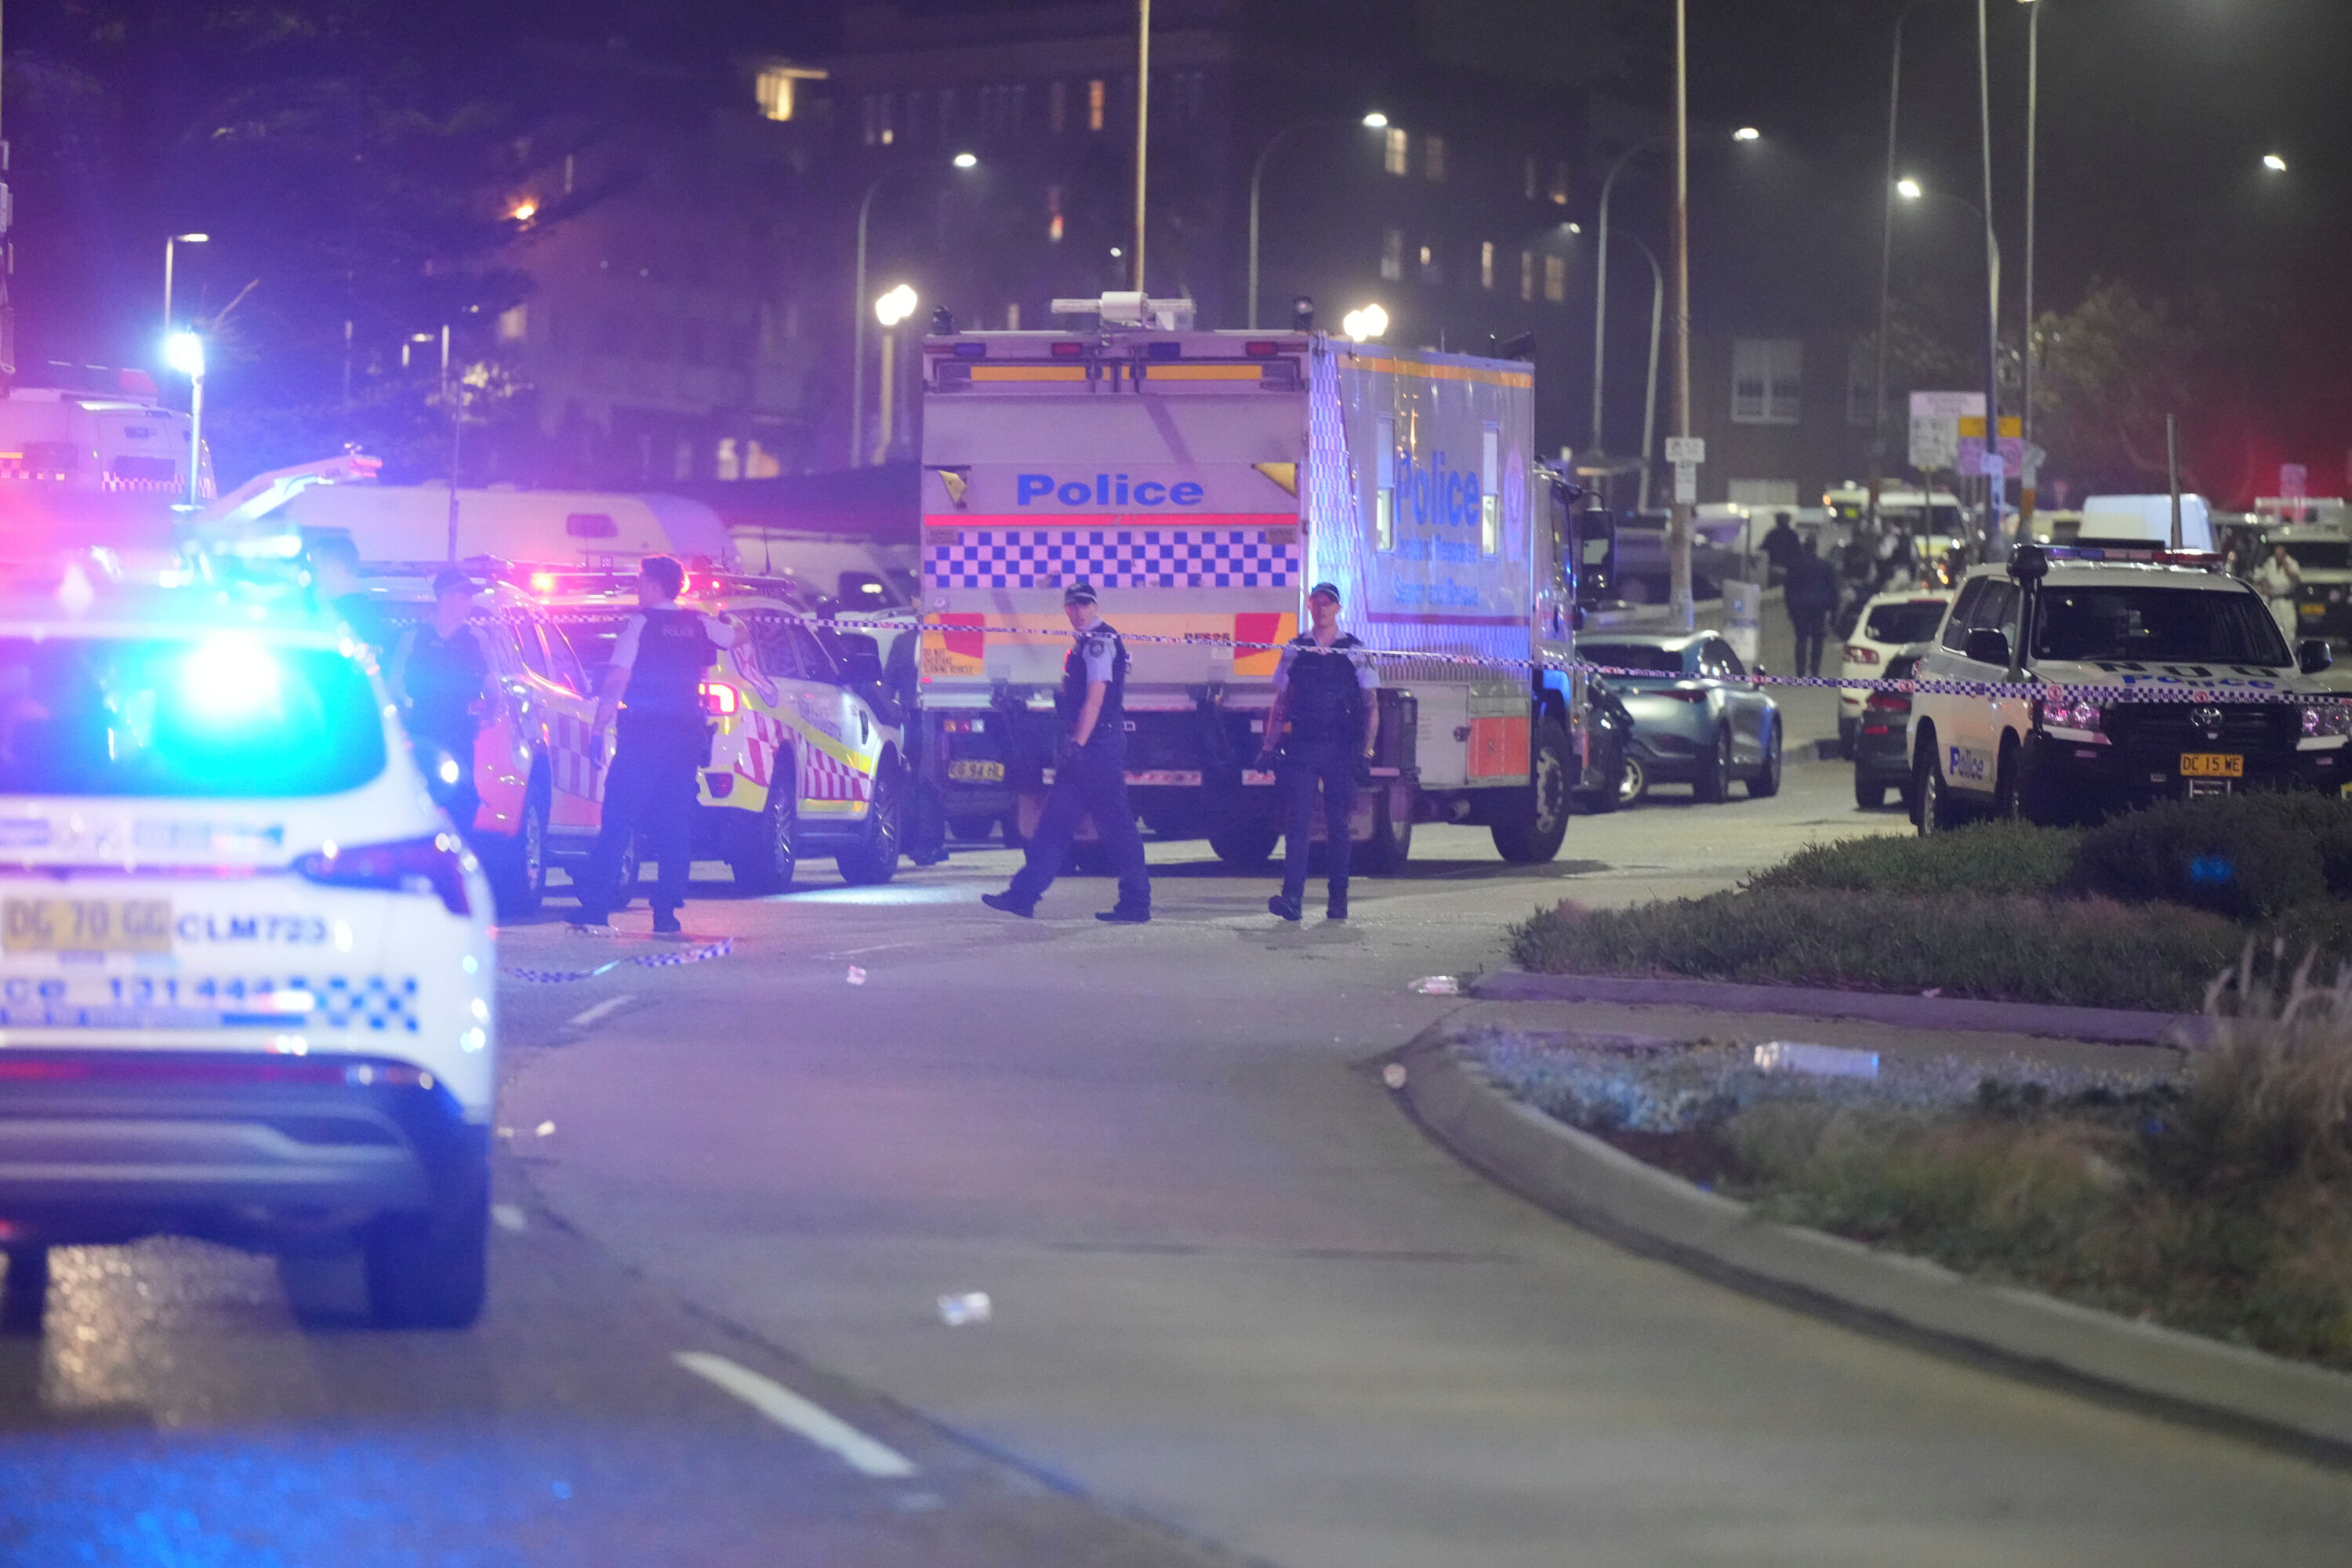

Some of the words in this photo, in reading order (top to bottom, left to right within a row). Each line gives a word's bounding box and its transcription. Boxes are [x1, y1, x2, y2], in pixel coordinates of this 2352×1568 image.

[1017, 474, 1204, 506] Police
[1396, 450, 1479, 527] Police
[2122, 674, 2274, 690] Police
[1950, 746, 1984, 782] Police
[2205, 757, 2220, 771] 15
